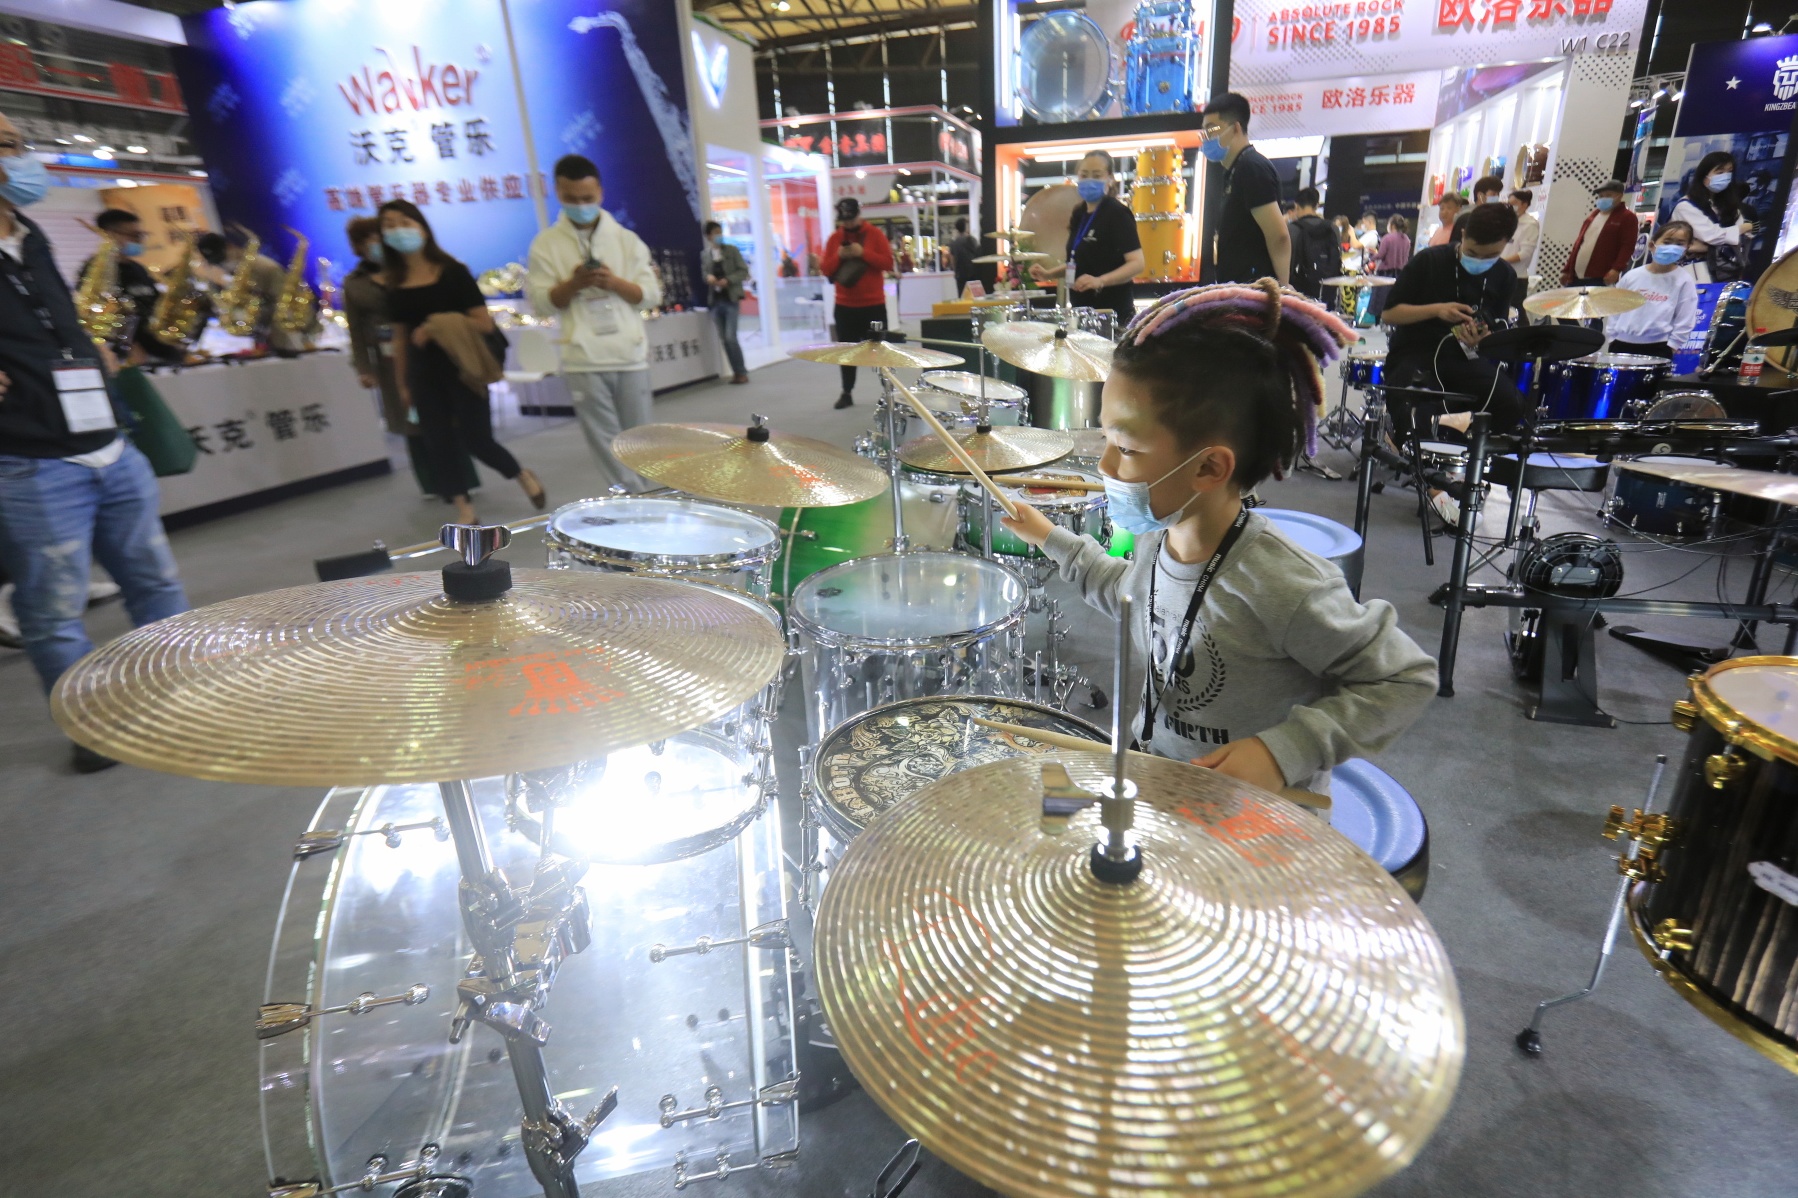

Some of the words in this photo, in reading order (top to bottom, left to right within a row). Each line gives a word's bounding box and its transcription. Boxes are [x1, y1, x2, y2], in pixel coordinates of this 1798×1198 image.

[1269, 1, 1355, 23] ABSOLUTE
[1357, 0, 1403, 13] ROCK
[1268, 20, 1337, 45] SINCE
[1347, 16, 1402, 38] 1985
[1561, 35, 1588, 54] W1
[1596, 31, 1631, 50] C22
[1321, 83, 1416, 110] 欧洛乐器
[1763, 102, 1797, 112] KINGZBEA
[1272, 102, 1303, 115] 1985
[1206, 553, 1222, 573] music
[1196, 574, 1210, 593] CHINA
[1163, 713, 1230, 745] FIRTH
